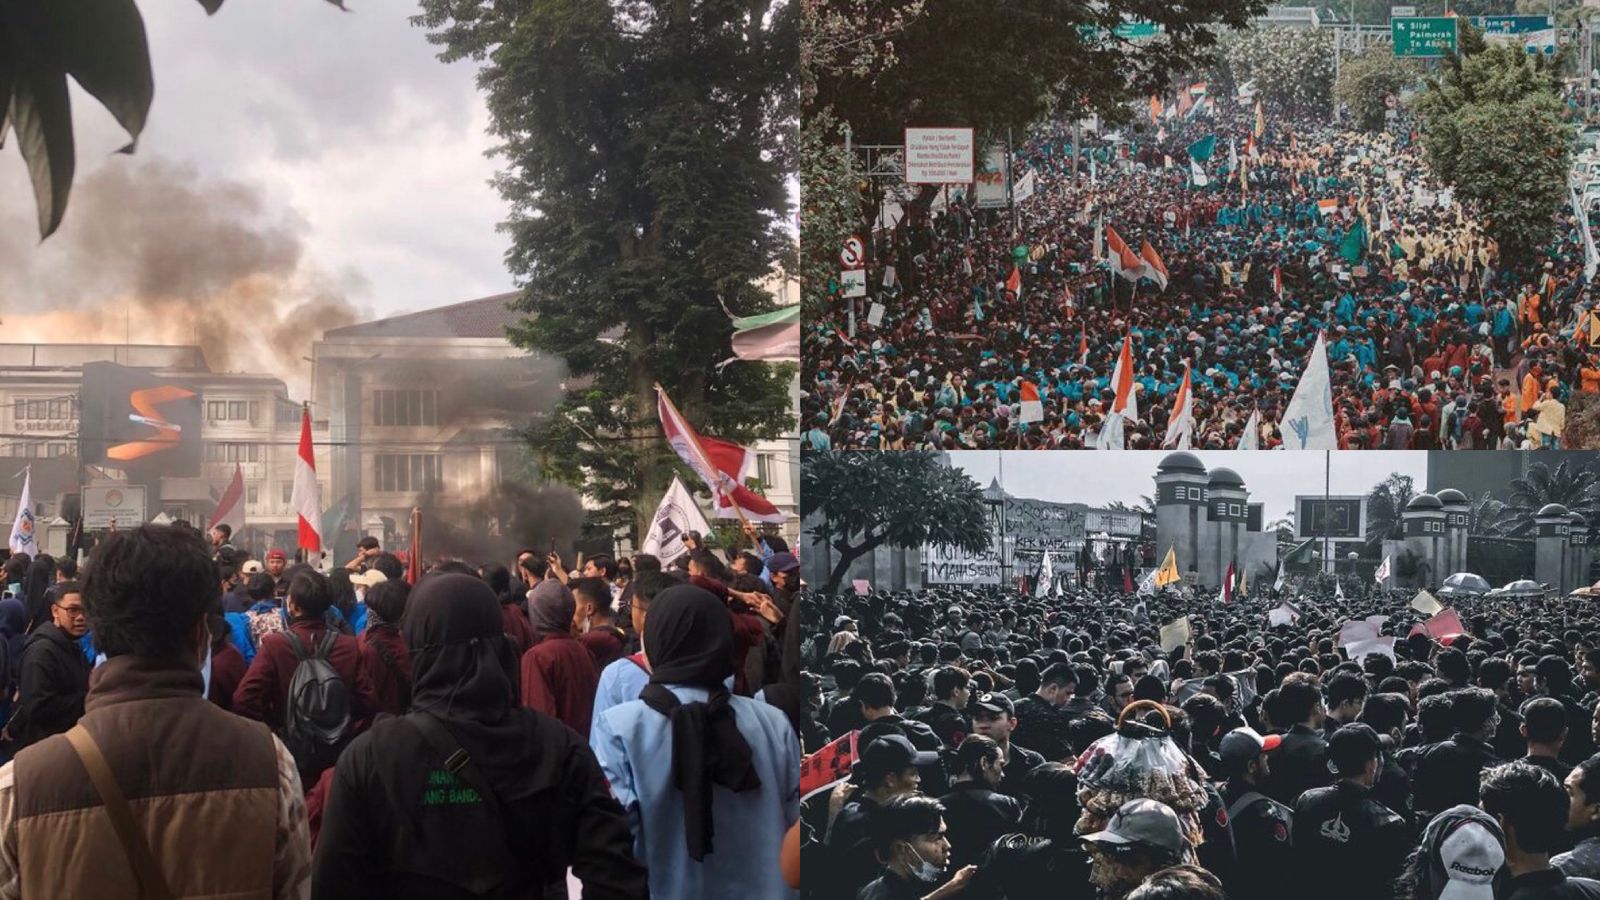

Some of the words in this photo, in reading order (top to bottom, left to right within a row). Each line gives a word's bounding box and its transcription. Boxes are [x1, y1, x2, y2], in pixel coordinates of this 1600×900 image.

[1409, 21, 1431, 31] Slipi
[1409, 31, 1452, 39] Palmerah
[448, 787, 483, 804] BAND
